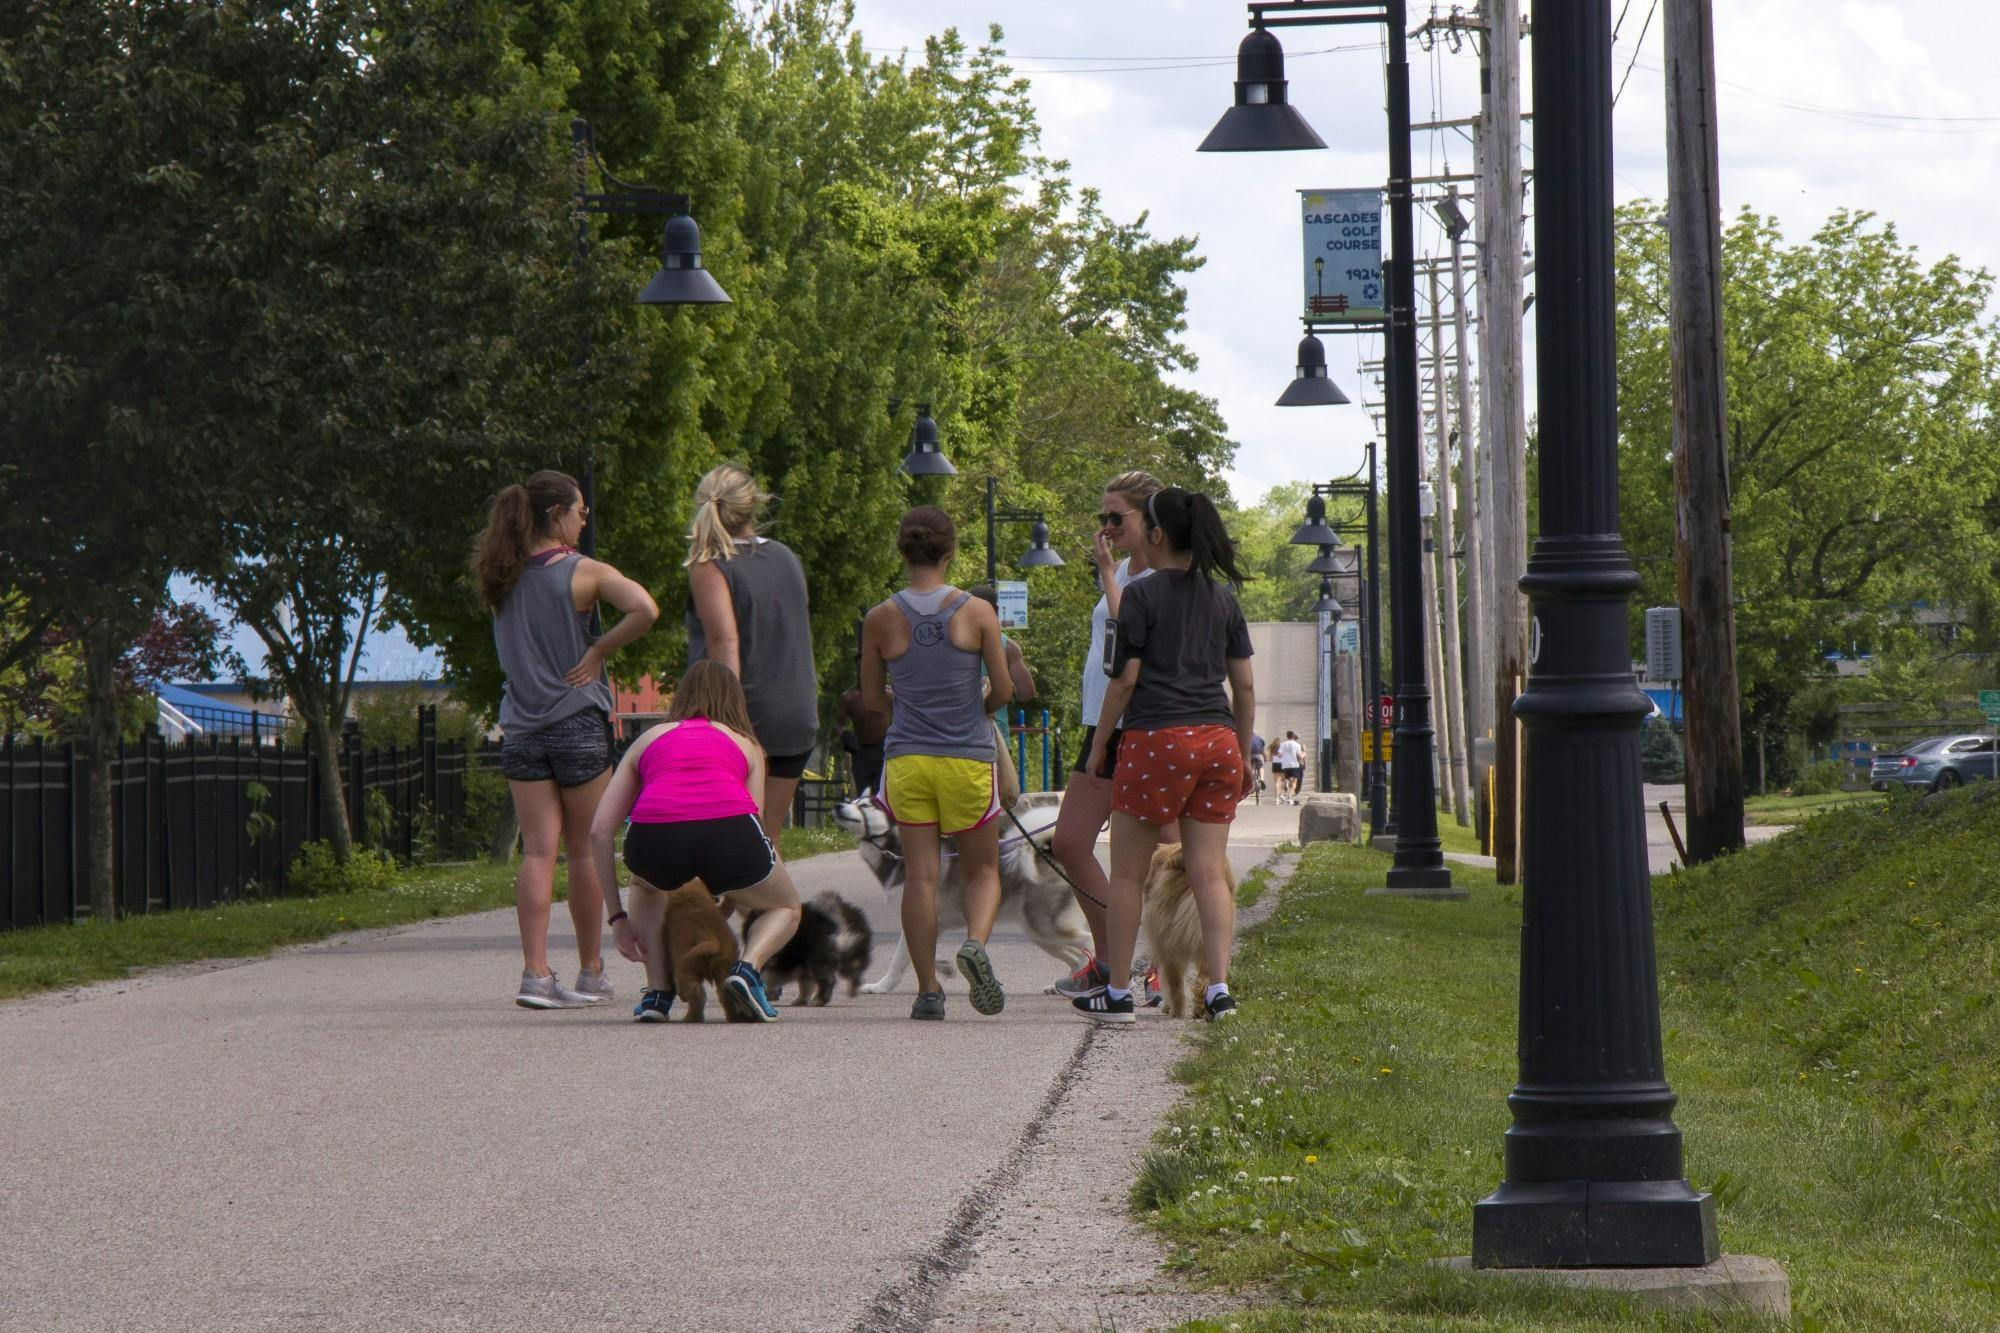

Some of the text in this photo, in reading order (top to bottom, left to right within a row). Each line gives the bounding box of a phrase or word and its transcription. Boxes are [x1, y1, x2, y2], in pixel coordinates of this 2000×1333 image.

[1305, 213, 1379, 224] CASCADES
[1342, 226, 1379, 237] GOLF
[1326, 240, 1380, 250] COURSE
[1346, 269, 1380, 280] 1924
